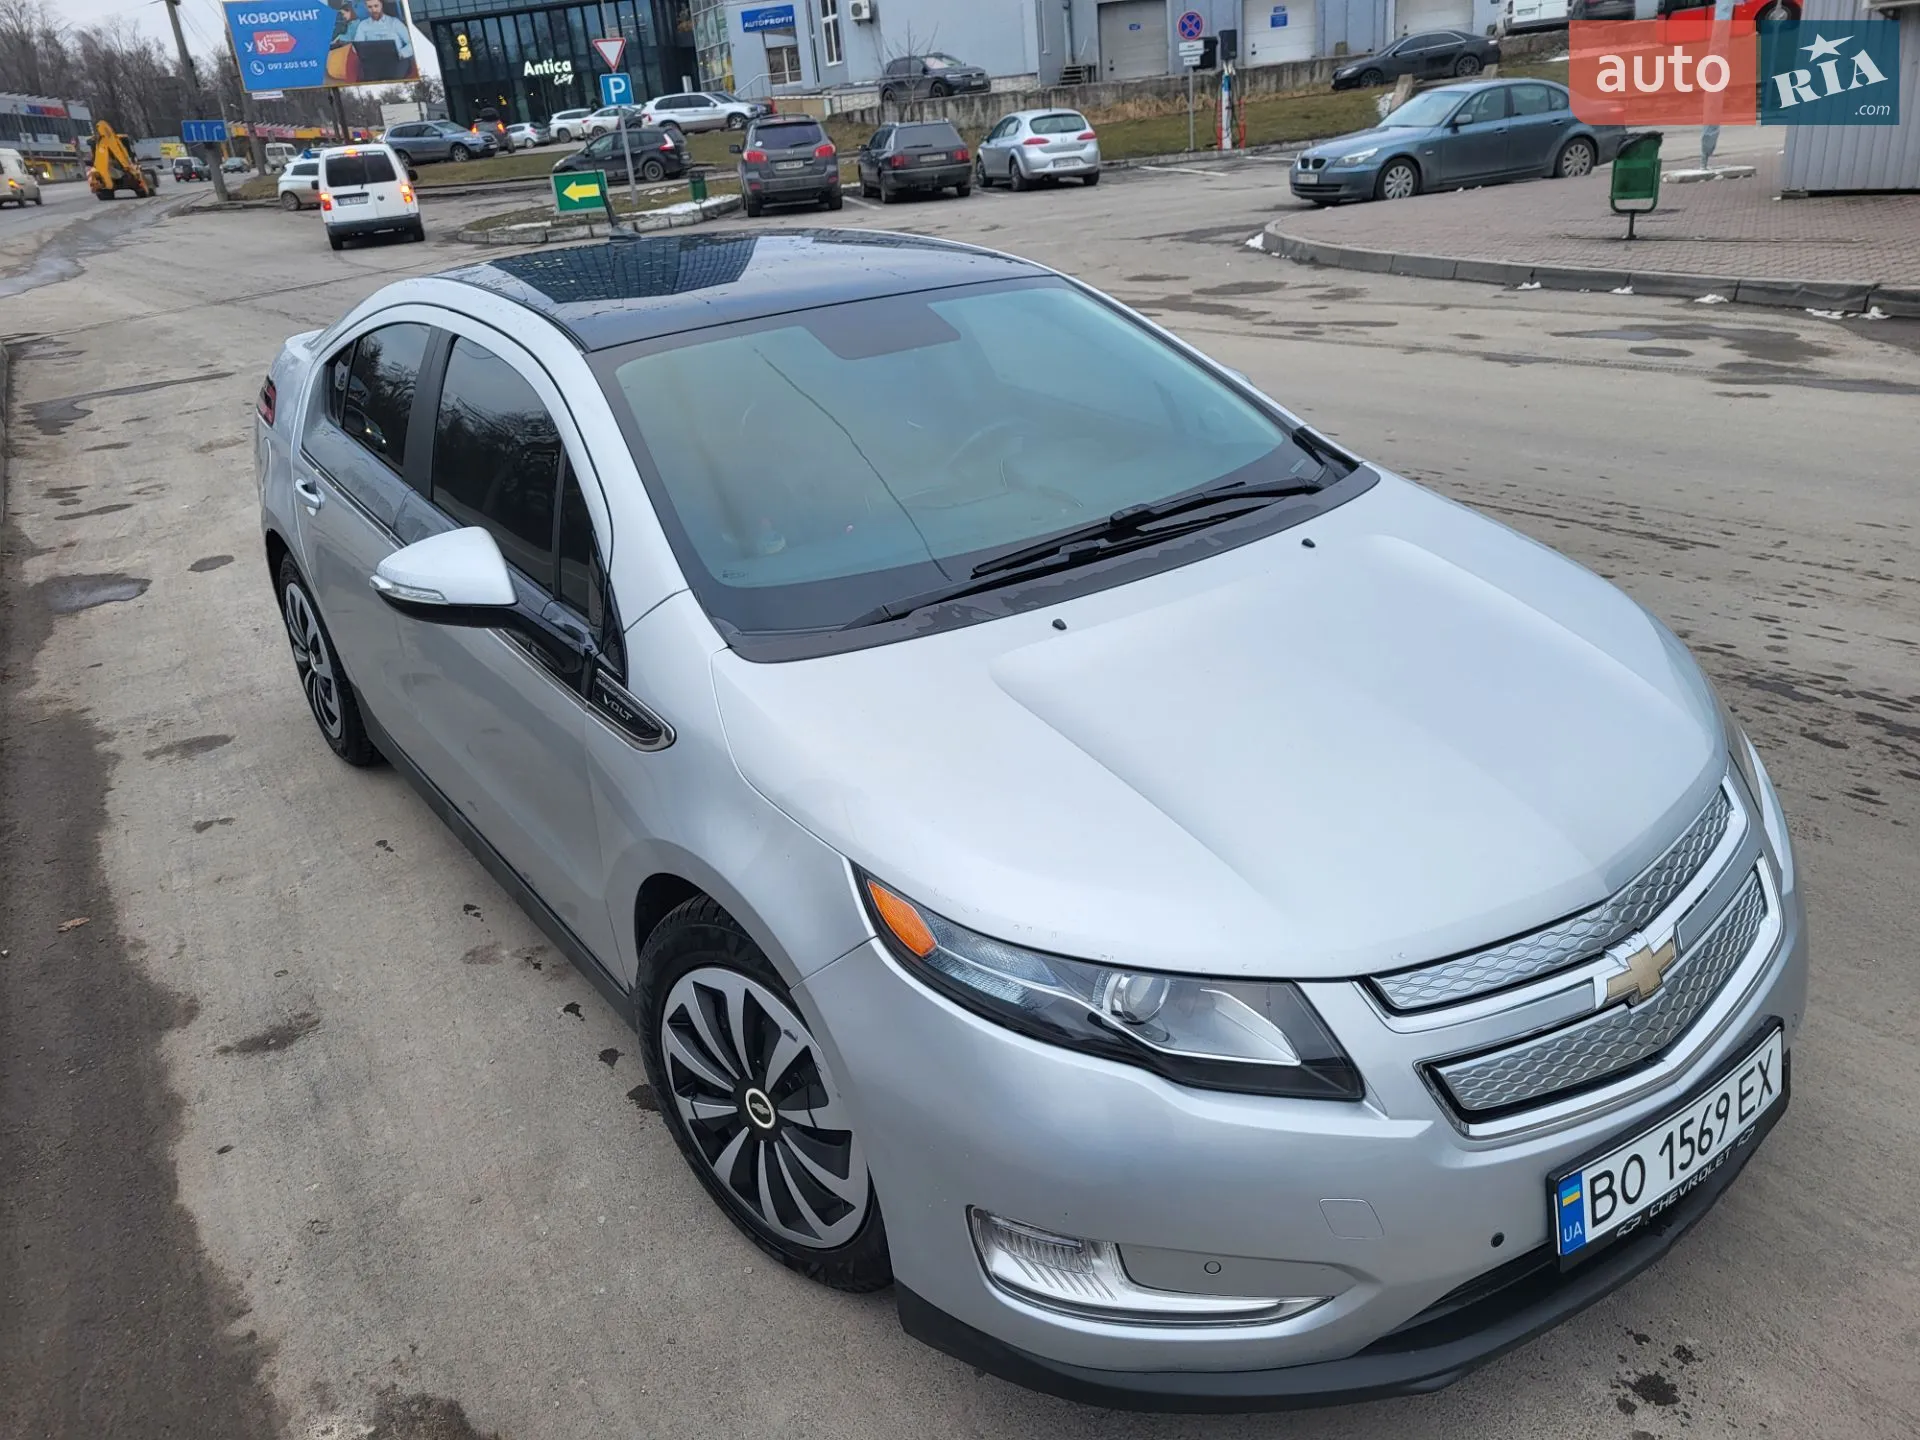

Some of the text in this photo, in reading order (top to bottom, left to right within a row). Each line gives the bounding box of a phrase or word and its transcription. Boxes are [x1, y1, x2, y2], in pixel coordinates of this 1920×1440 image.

[238, 9, 320, 25] КОВОРКІНГ
[744, 15, 793, 28] AUTOPROFIT
[524, 58, 572, 77] Antica
[609, 77, 625, 103] P
[604, 693, 633, 720] VOLT
[1589, 1049, 1775, 1229] BO 1569 EX
[1648, 1147, 1732, 1218] CHEVROLET
[1563, 1221, 1583, 1244] UA
